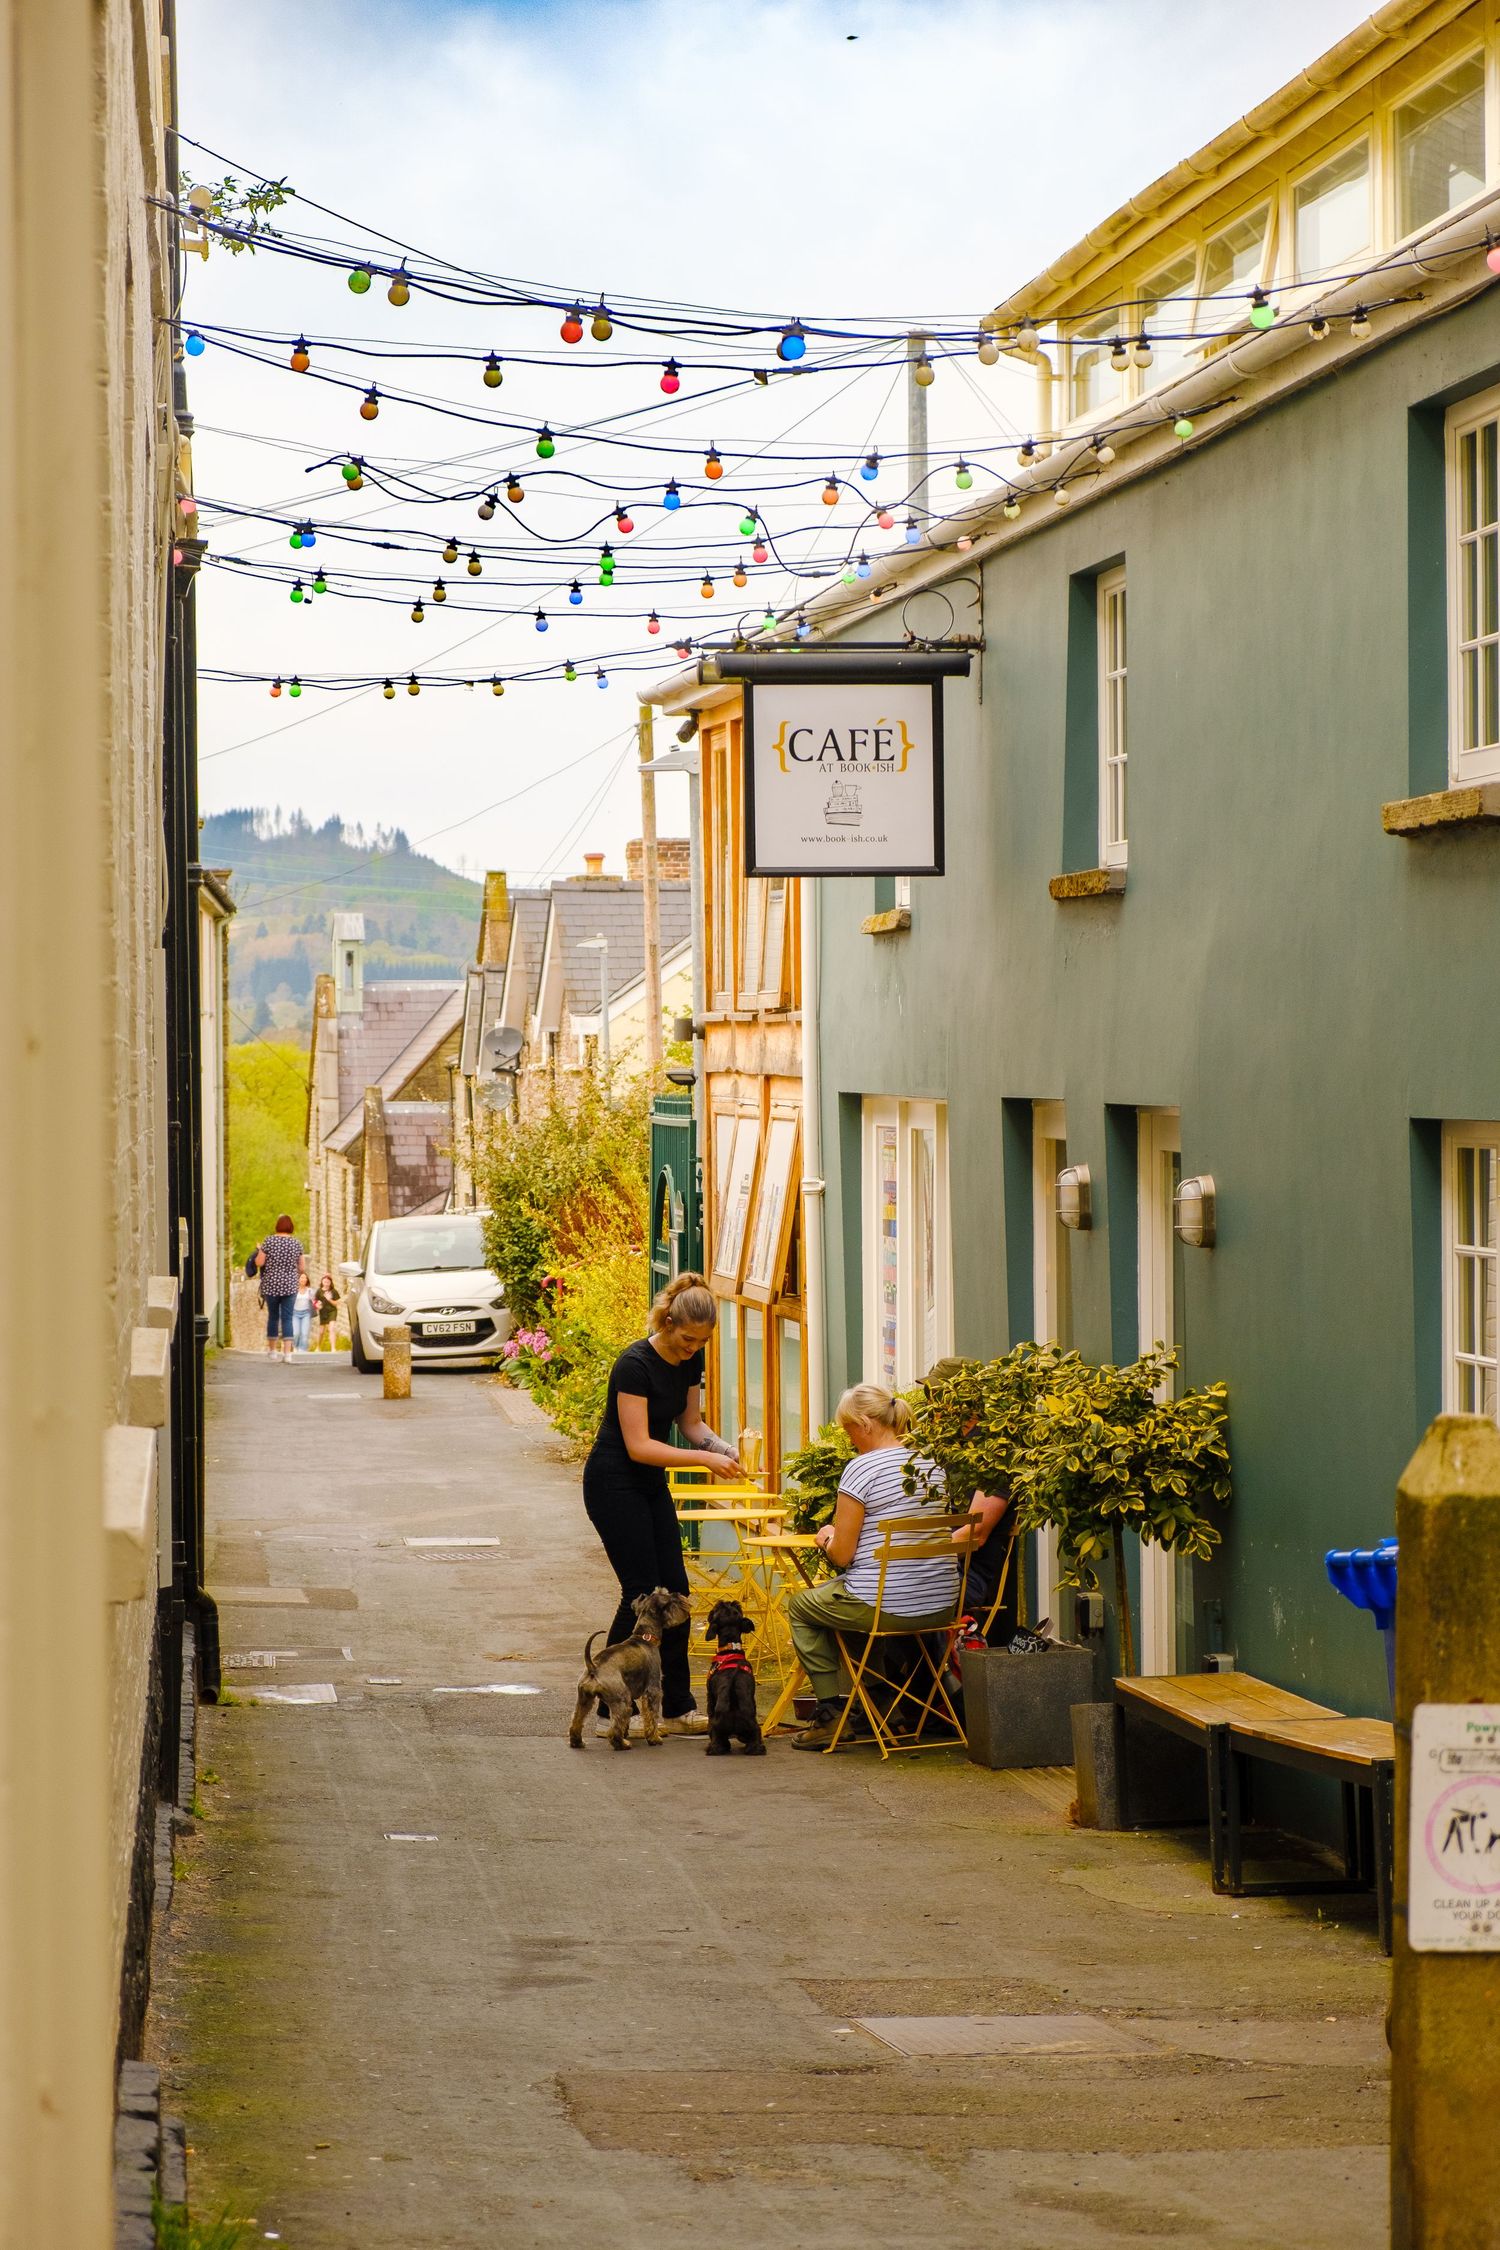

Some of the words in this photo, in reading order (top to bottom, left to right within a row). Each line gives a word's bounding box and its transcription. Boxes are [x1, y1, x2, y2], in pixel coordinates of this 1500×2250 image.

[819, 763, 834, 773] AT
[427, 1324, 451, 1333] CV62
[453, 1323, 472, 1332] FSN
[1466, 1721, 1500, 1737] Powy
[1433, 1898, 1471, 1909] CLEAN
[1475, 1898, 1490, 1909] UP
[1453, 1910, 1482, 1921] YOUR
